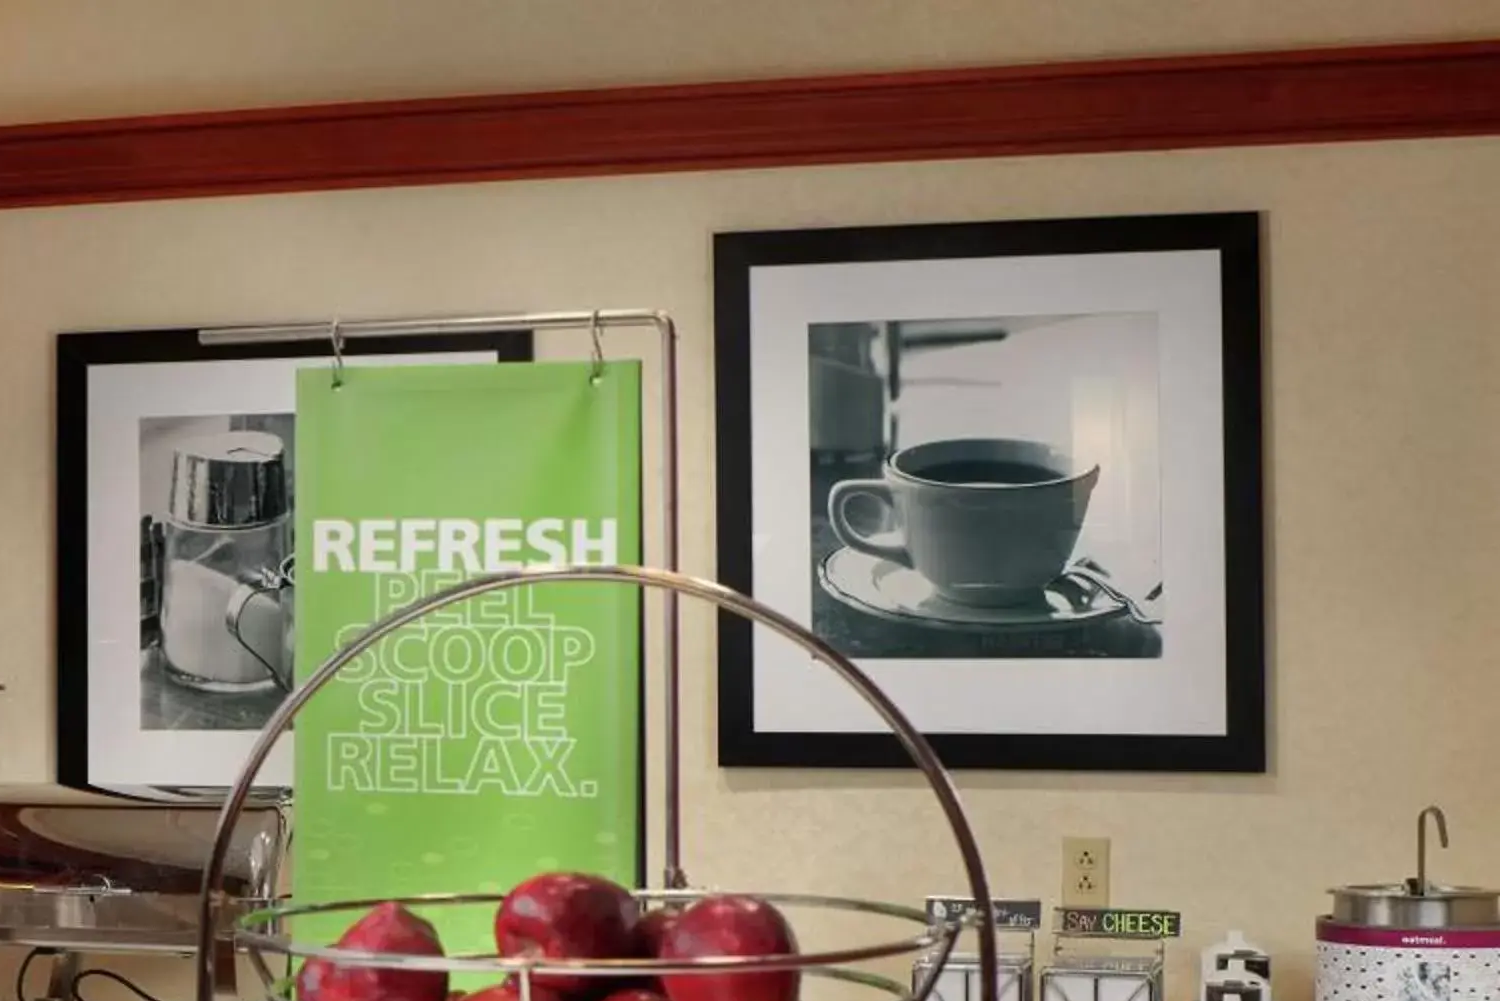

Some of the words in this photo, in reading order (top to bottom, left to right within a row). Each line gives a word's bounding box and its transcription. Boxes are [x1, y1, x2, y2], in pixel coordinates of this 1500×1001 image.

[312, 518, 618, 573] REFRESH
[375, 569, 555, 628] PEEL
[334, 622, 596, 686] SCOOP
[357, 677, 568, 741] SLICE
[327, 733, 599, 798] RELAX.
[1102, 912, 1177, 936] CHEESE
